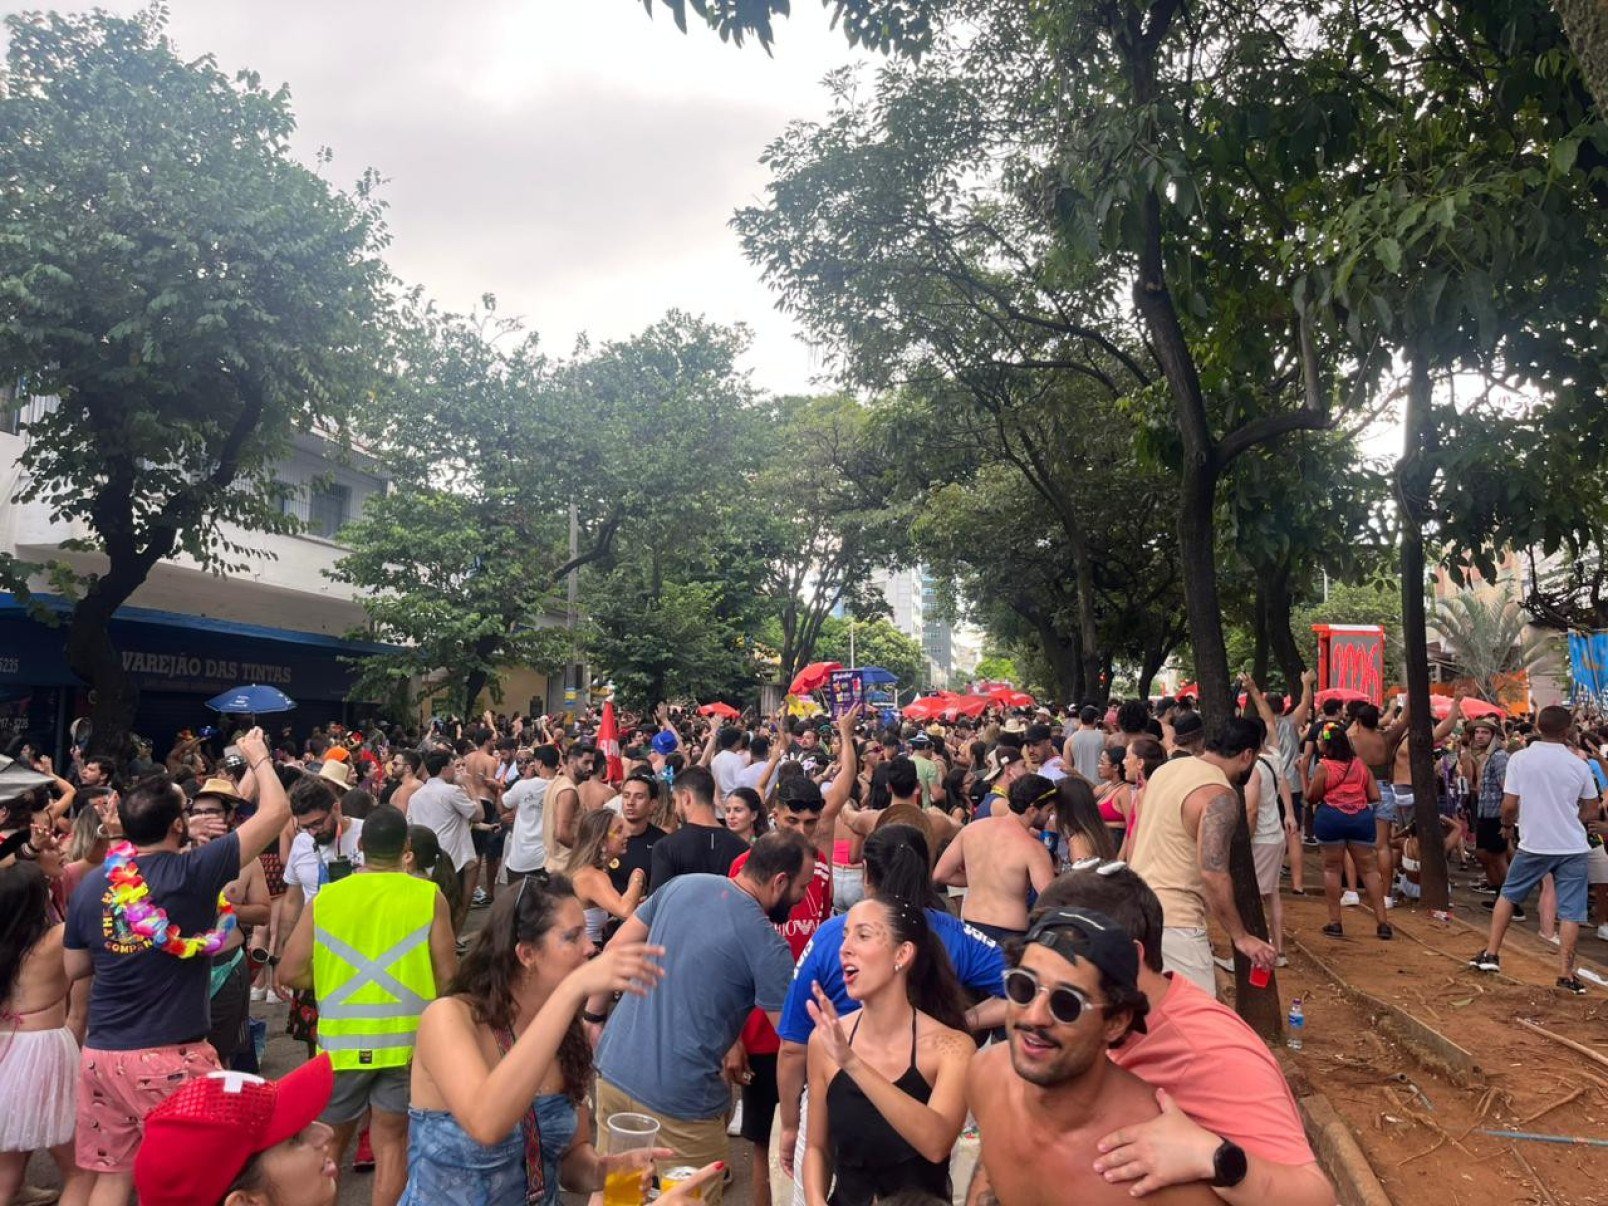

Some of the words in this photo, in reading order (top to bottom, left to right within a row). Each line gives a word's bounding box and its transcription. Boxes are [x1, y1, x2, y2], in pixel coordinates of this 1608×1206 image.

[121, 651, 201, 678] VAREJÃO
[205, 659, 238, 679] DAS
[243, 663, 292, 683] TINTAS
[104, 940, 153, 953] COMPAN
